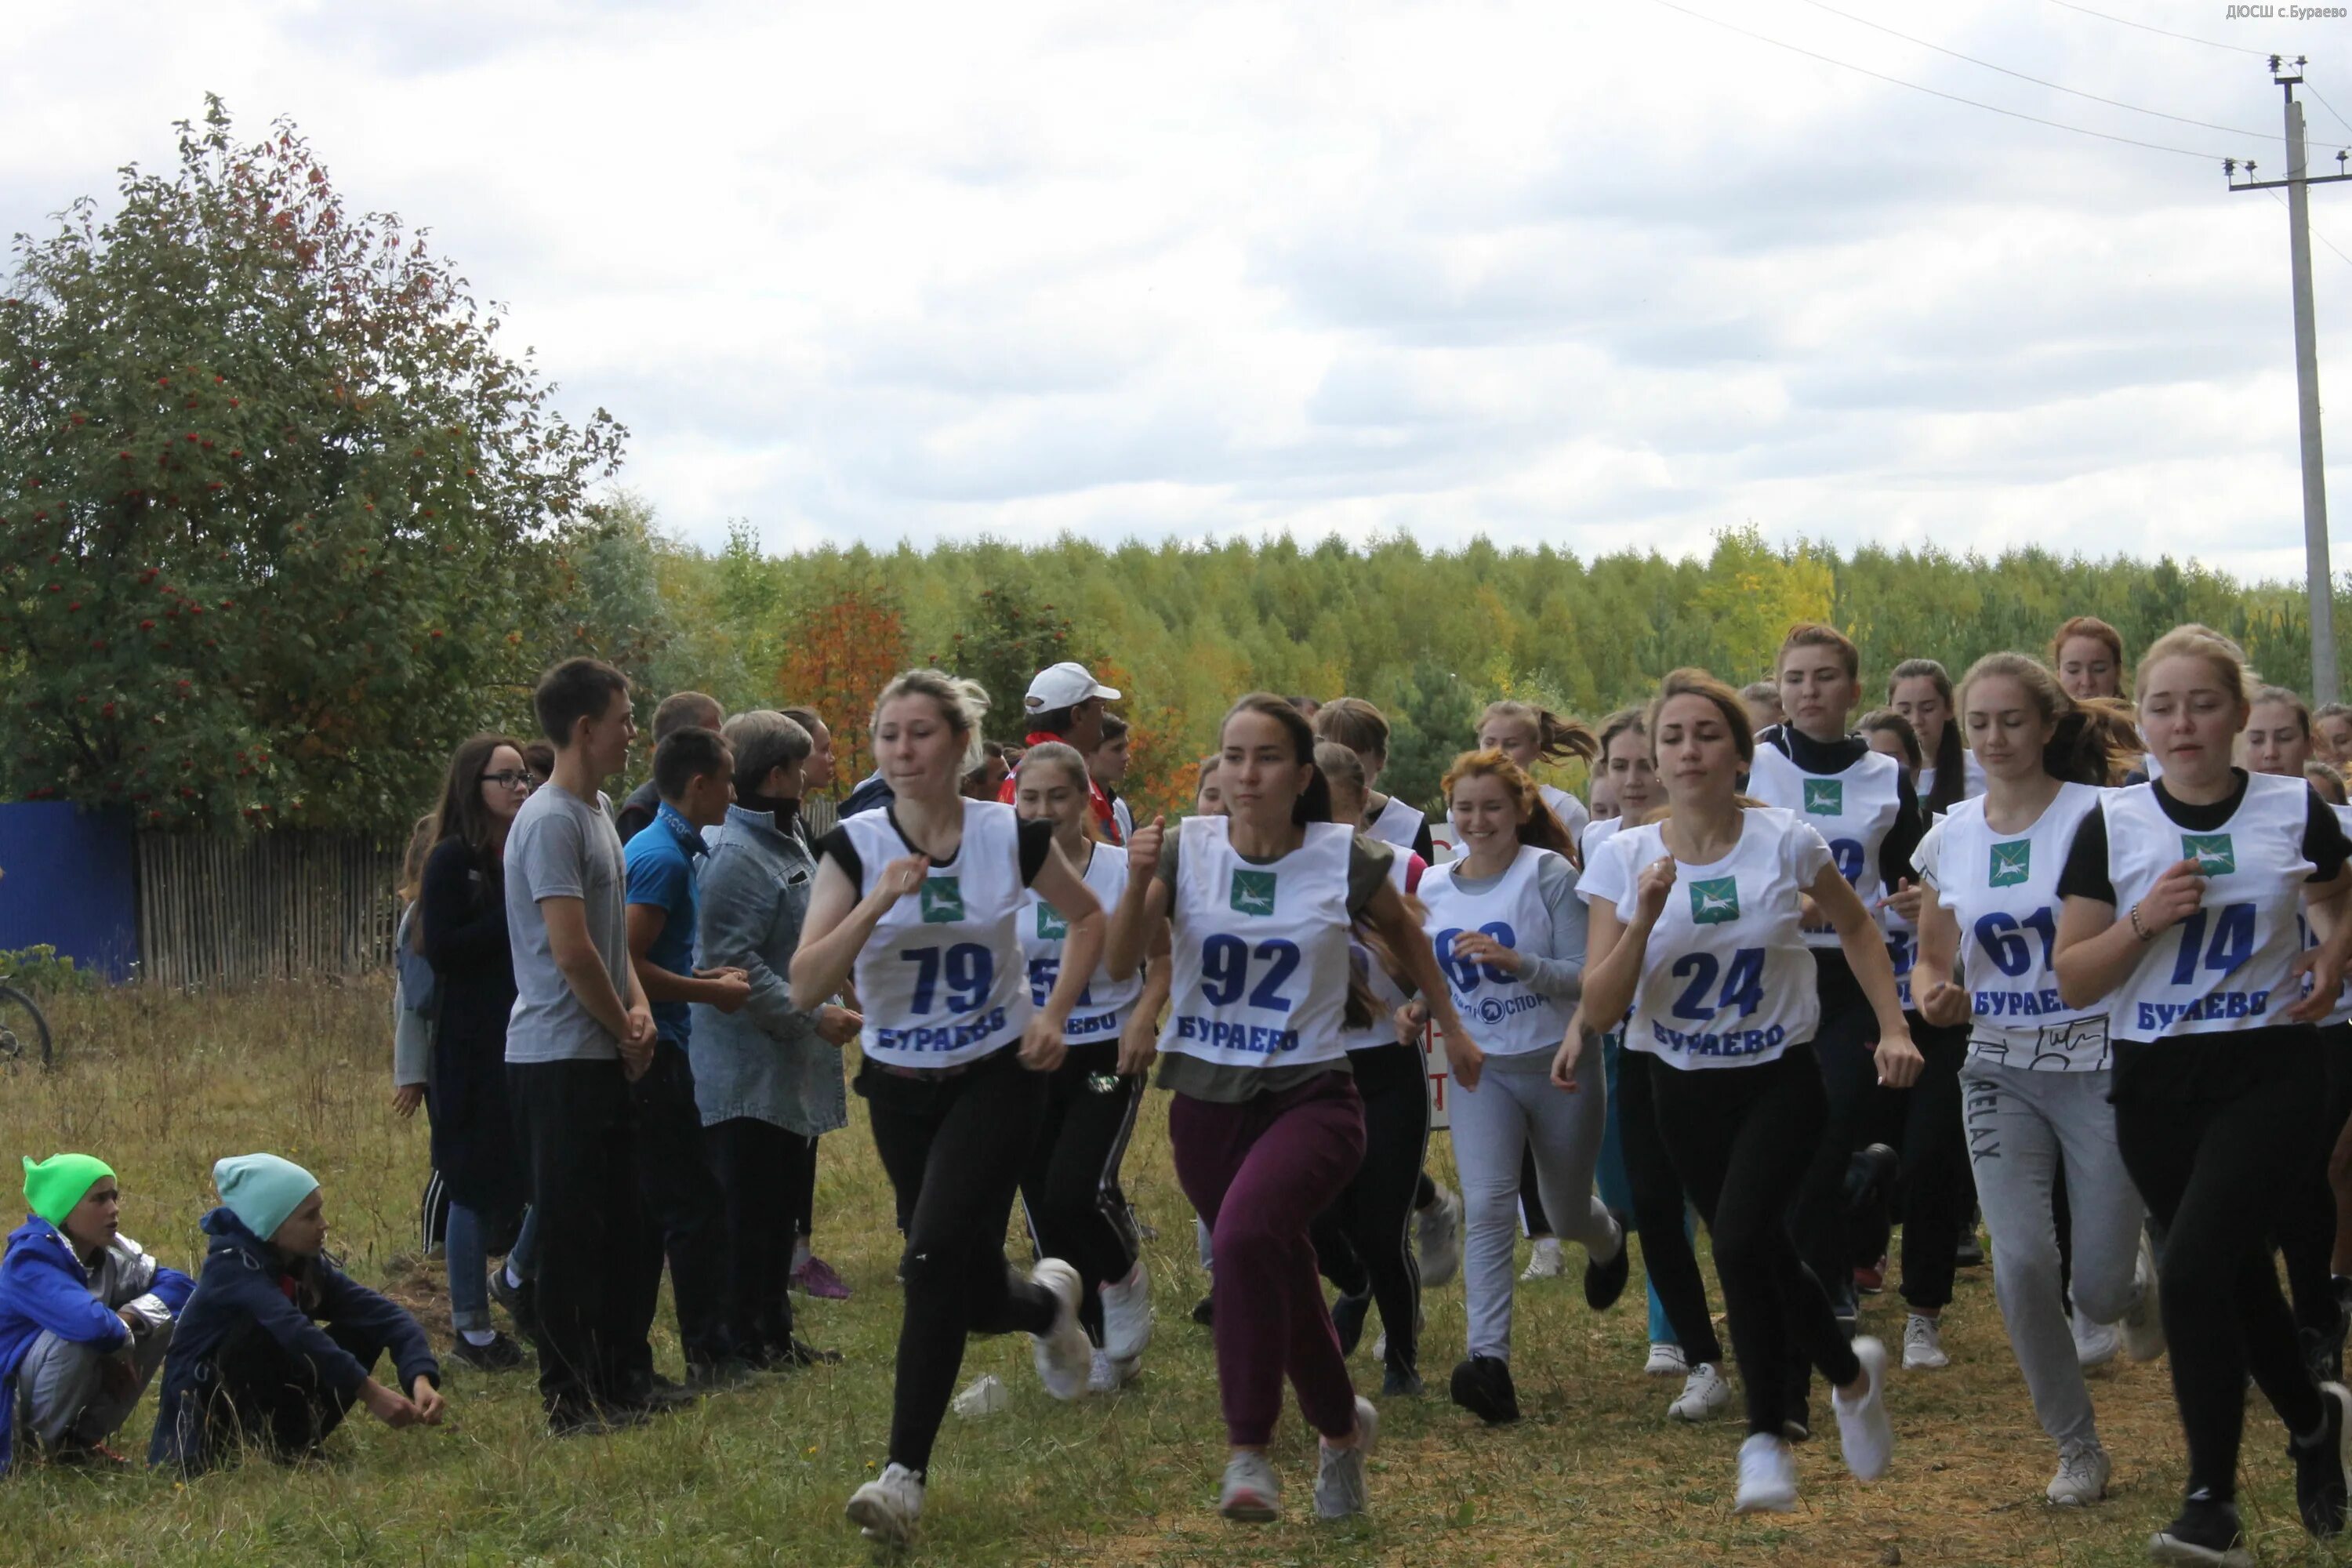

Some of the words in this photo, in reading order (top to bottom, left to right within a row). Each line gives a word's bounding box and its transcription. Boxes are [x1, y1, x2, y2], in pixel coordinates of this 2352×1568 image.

[1201, 933, 1301, 1013] 92
[1974, 906, 2056, 977] 61
[2171, 903, 2257, 985] 74
[900, 942, 994, 1014] 79
[1671, 947, 1766, 1020] 24
[1974, 989, 2072, 1016] БУРАЕ
[1177, 1016, 1299, 1054] БУРАЕВО
[1652, 1019, 1785, 1056] БУРАЕВО
[1968, 1080, 2001, 1166] RELAX
